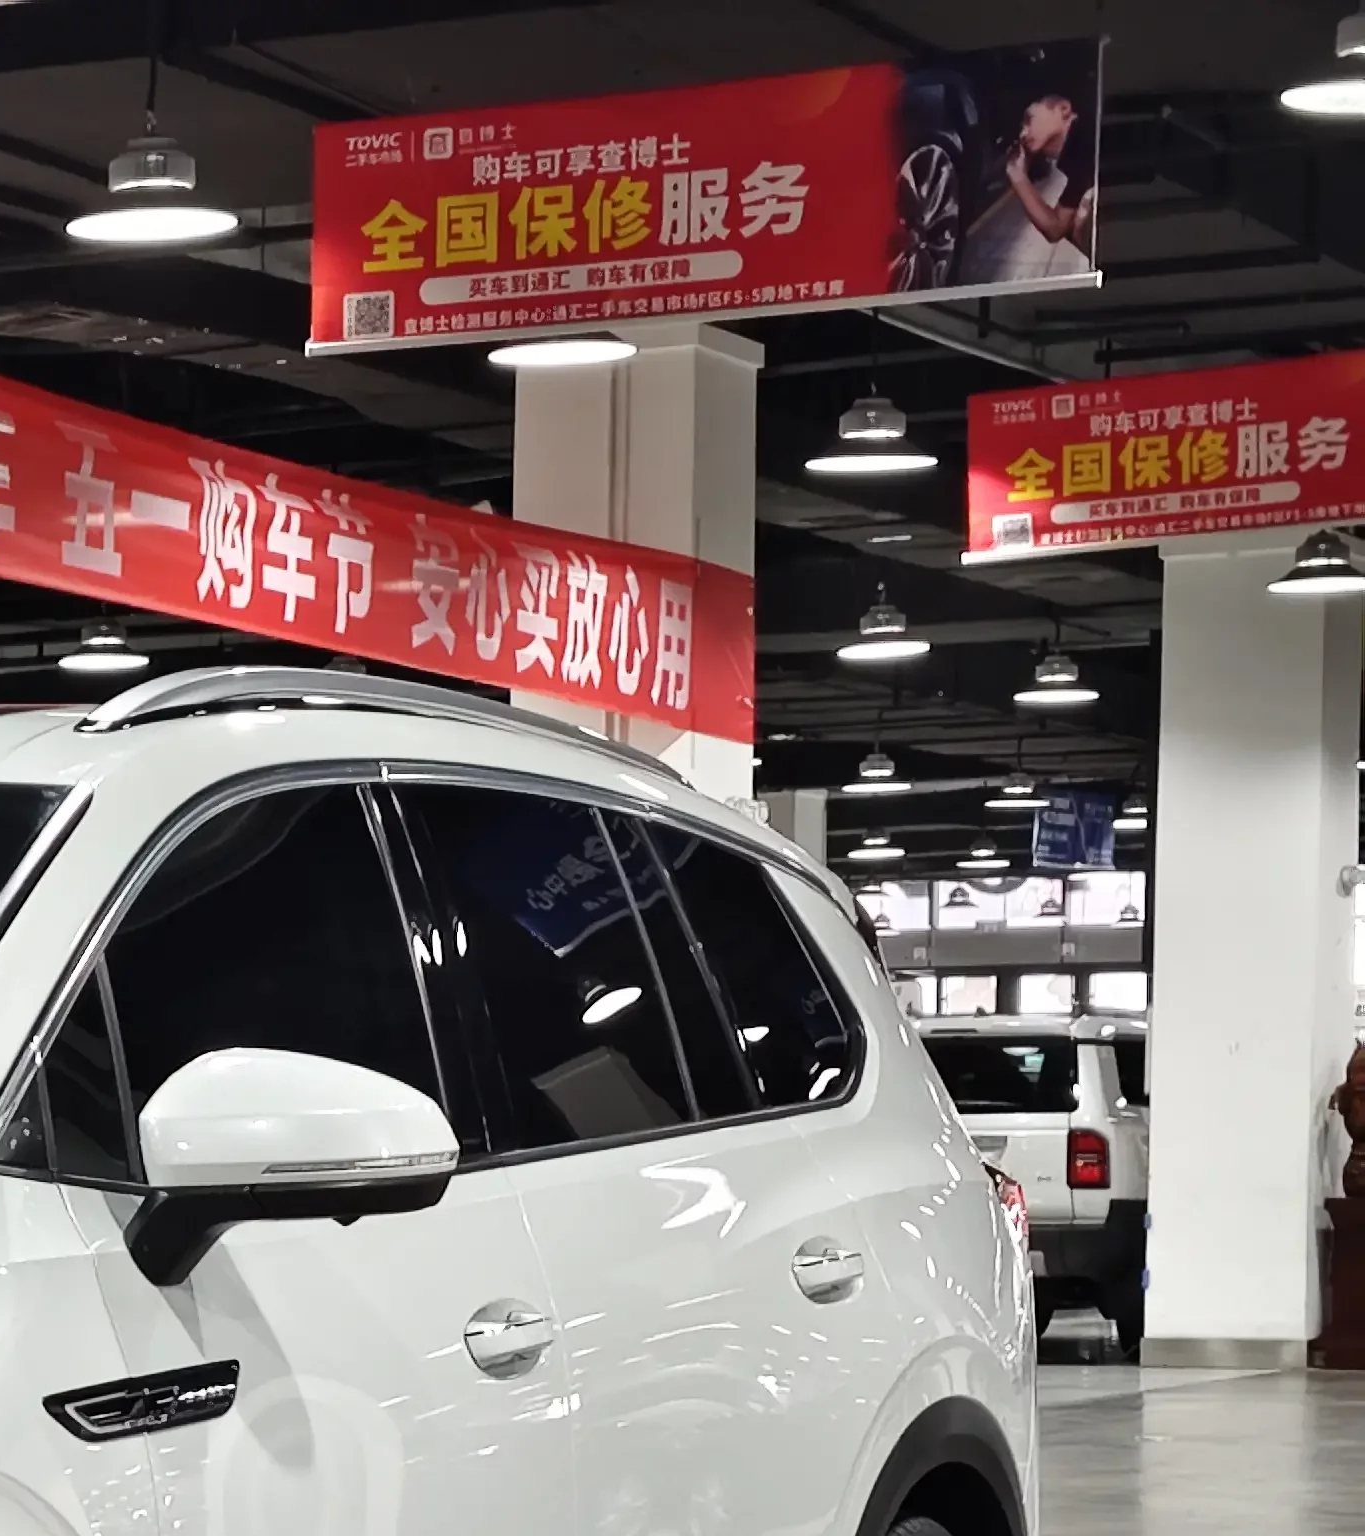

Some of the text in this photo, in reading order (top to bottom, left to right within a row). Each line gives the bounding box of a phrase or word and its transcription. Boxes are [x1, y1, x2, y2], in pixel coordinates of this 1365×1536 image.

[345, 132, 403, 151] TOVIC
[472, 134, 691, 186] 购车可享查博士
[361, 161, 810, 274] 全国保修服务
[469, 258, 691, 298] 买车到通汇 购车有保障
[1089, 398, 1259, 438] 购车可享查博士
[1005, 416, 1351, 503] 全国保修服务
[61, 418, 376, 634] 五一购车节
[408, 513, 693, 711] 安心买放心用
